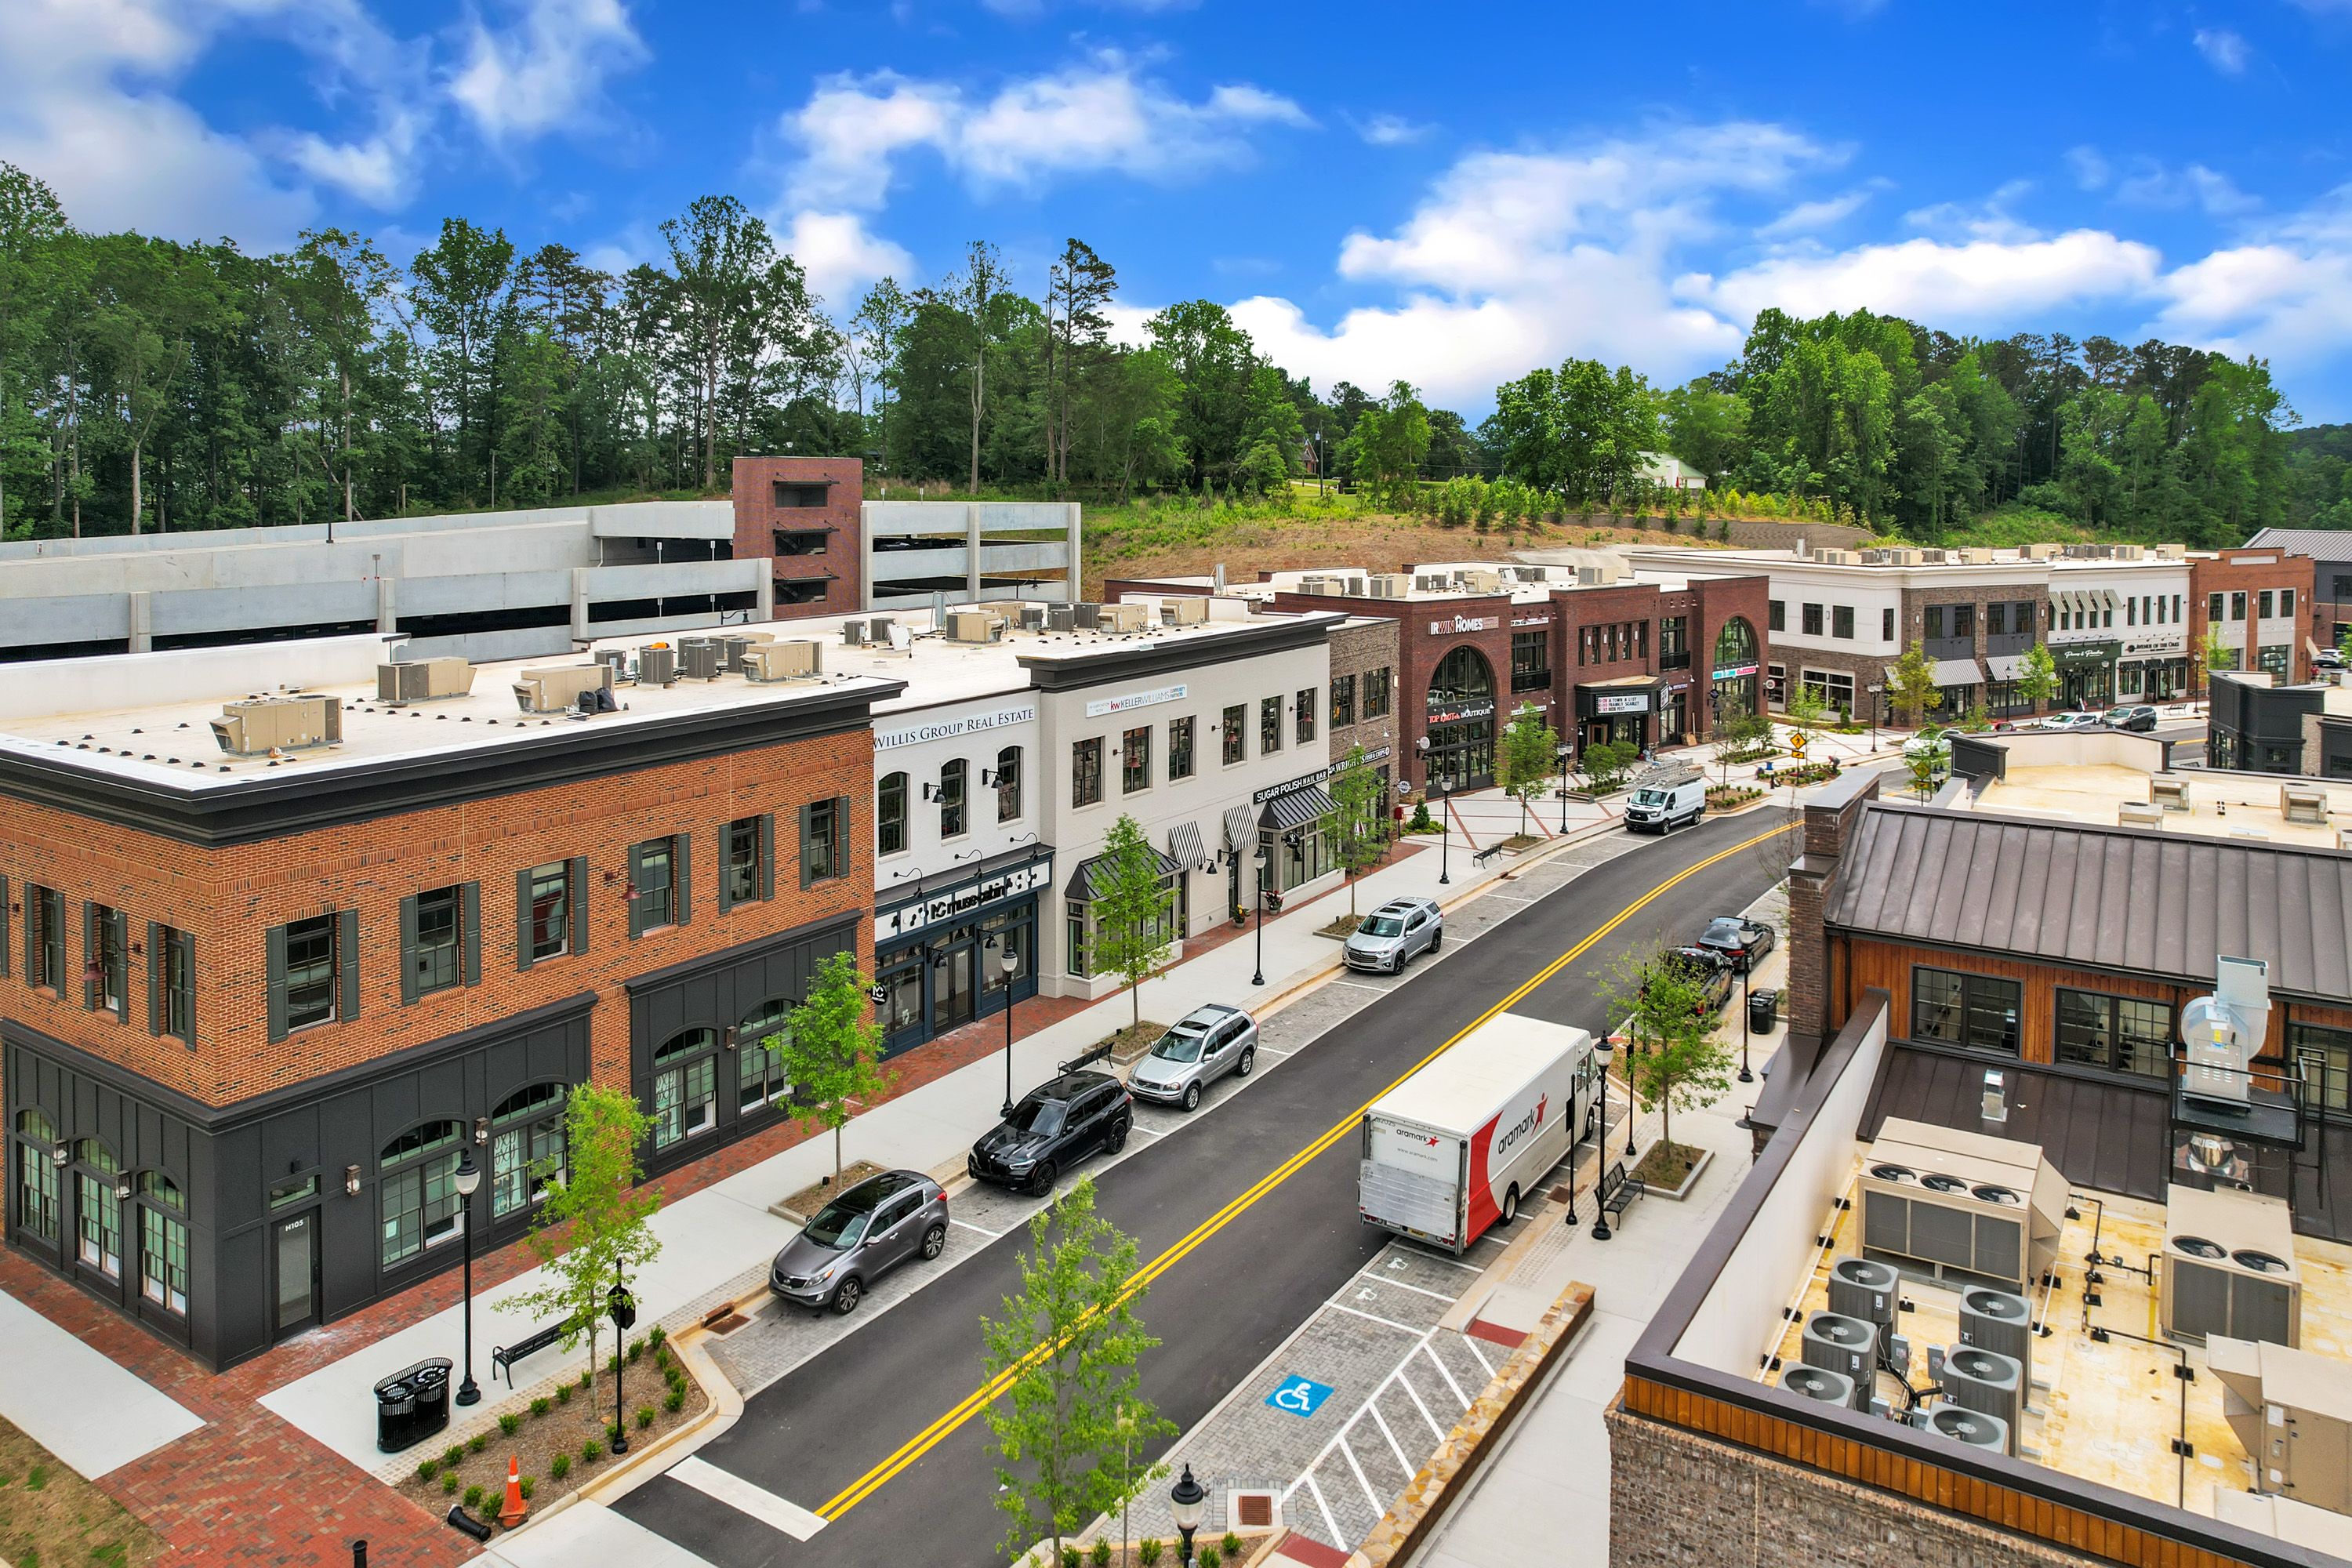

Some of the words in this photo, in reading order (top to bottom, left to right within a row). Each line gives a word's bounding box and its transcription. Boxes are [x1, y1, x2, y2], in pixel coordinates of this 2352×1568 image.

[1431, 621, 1454, 635] IRWIN
[1455, 615, 1483, 633] HOMES
[1110, 700, 1120, 710] kw
[1428, 715, 1440, 724] TOP
[1461, 708, 1491, 718] BOUTIQUE
[874, 731, 916, 750] WILLIS
[920, 722, 963, 740] GROUP
[967, 717, 993, 731] REAL
[998, 709, 1033, 725] ESTATE
[1257, 786, 1279, 802] SUGAR
[1280, 779, 1302, 794] POLISH
[1302, 776, 1316, 785] NAIL
[1316, 771, 1327, 780] BAR
[1396, 1129, 1428, 1143] aramark
[1498, 1108, 1535, 1155] aramark
[285, 1219, 304, 1232] H105
